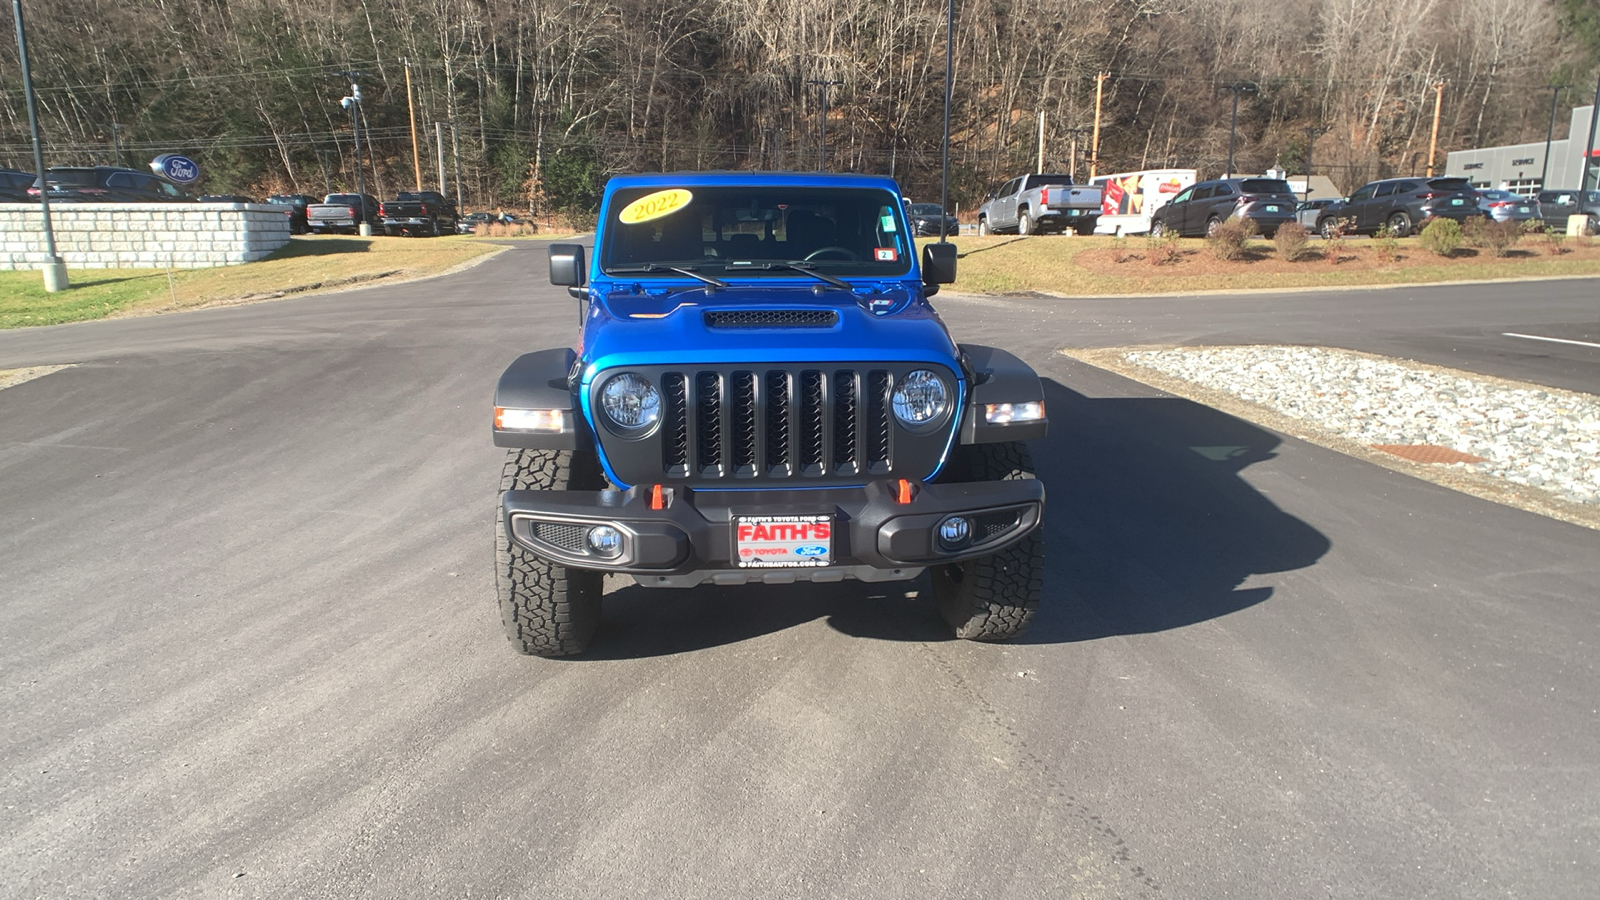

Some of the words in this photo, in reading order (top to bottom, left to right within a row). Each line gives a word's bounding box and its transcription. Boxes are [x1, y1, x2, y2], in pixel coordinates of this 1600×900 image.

[170, 159, 194, 179] Ford
[634, 193, 678, 220] 2022
[738, 523, 831, 541] FAITH'S
[801, 546, 821, 555] Ford
